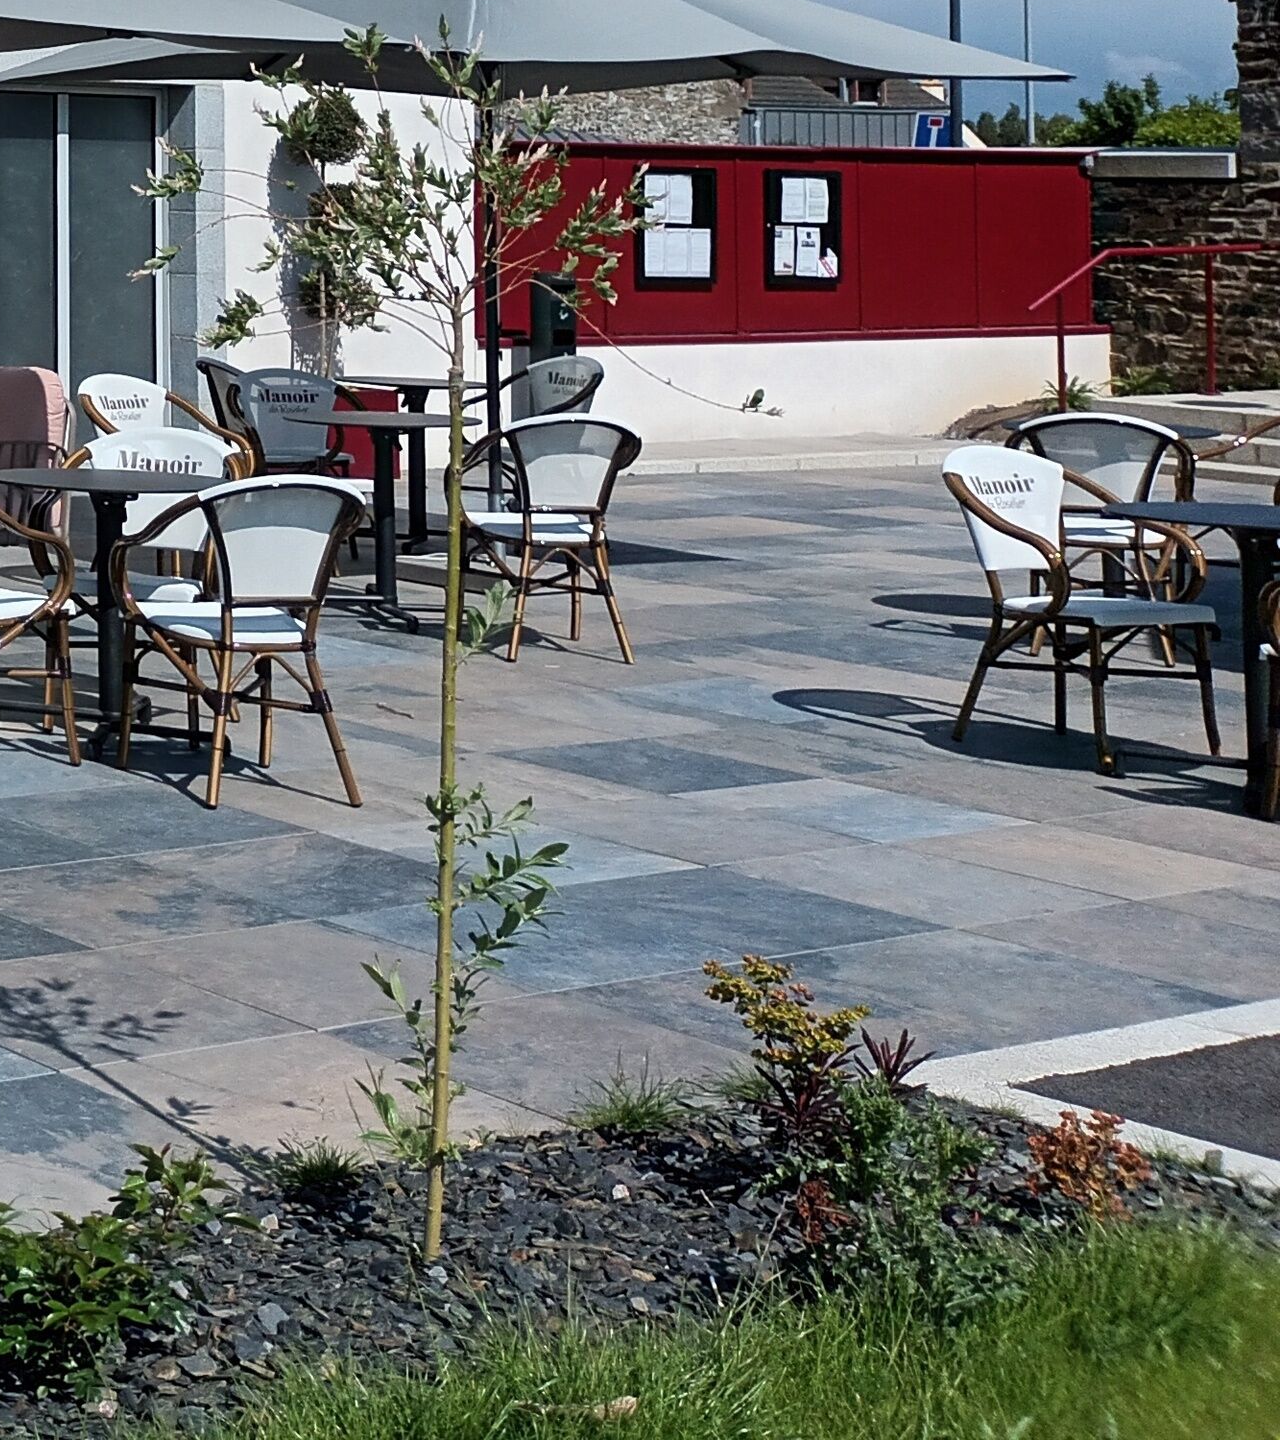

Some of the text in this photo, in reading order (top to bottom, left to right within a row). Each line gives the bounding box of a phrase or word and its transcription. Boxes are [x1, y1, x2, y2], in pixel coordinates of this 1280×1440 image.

[99, 393, 150, 411] Manoir
[260, 388, 320, 404] Manoir
[117, 449, 203, 475] Manoir
[968, 472, 1036, 496] Manoir
